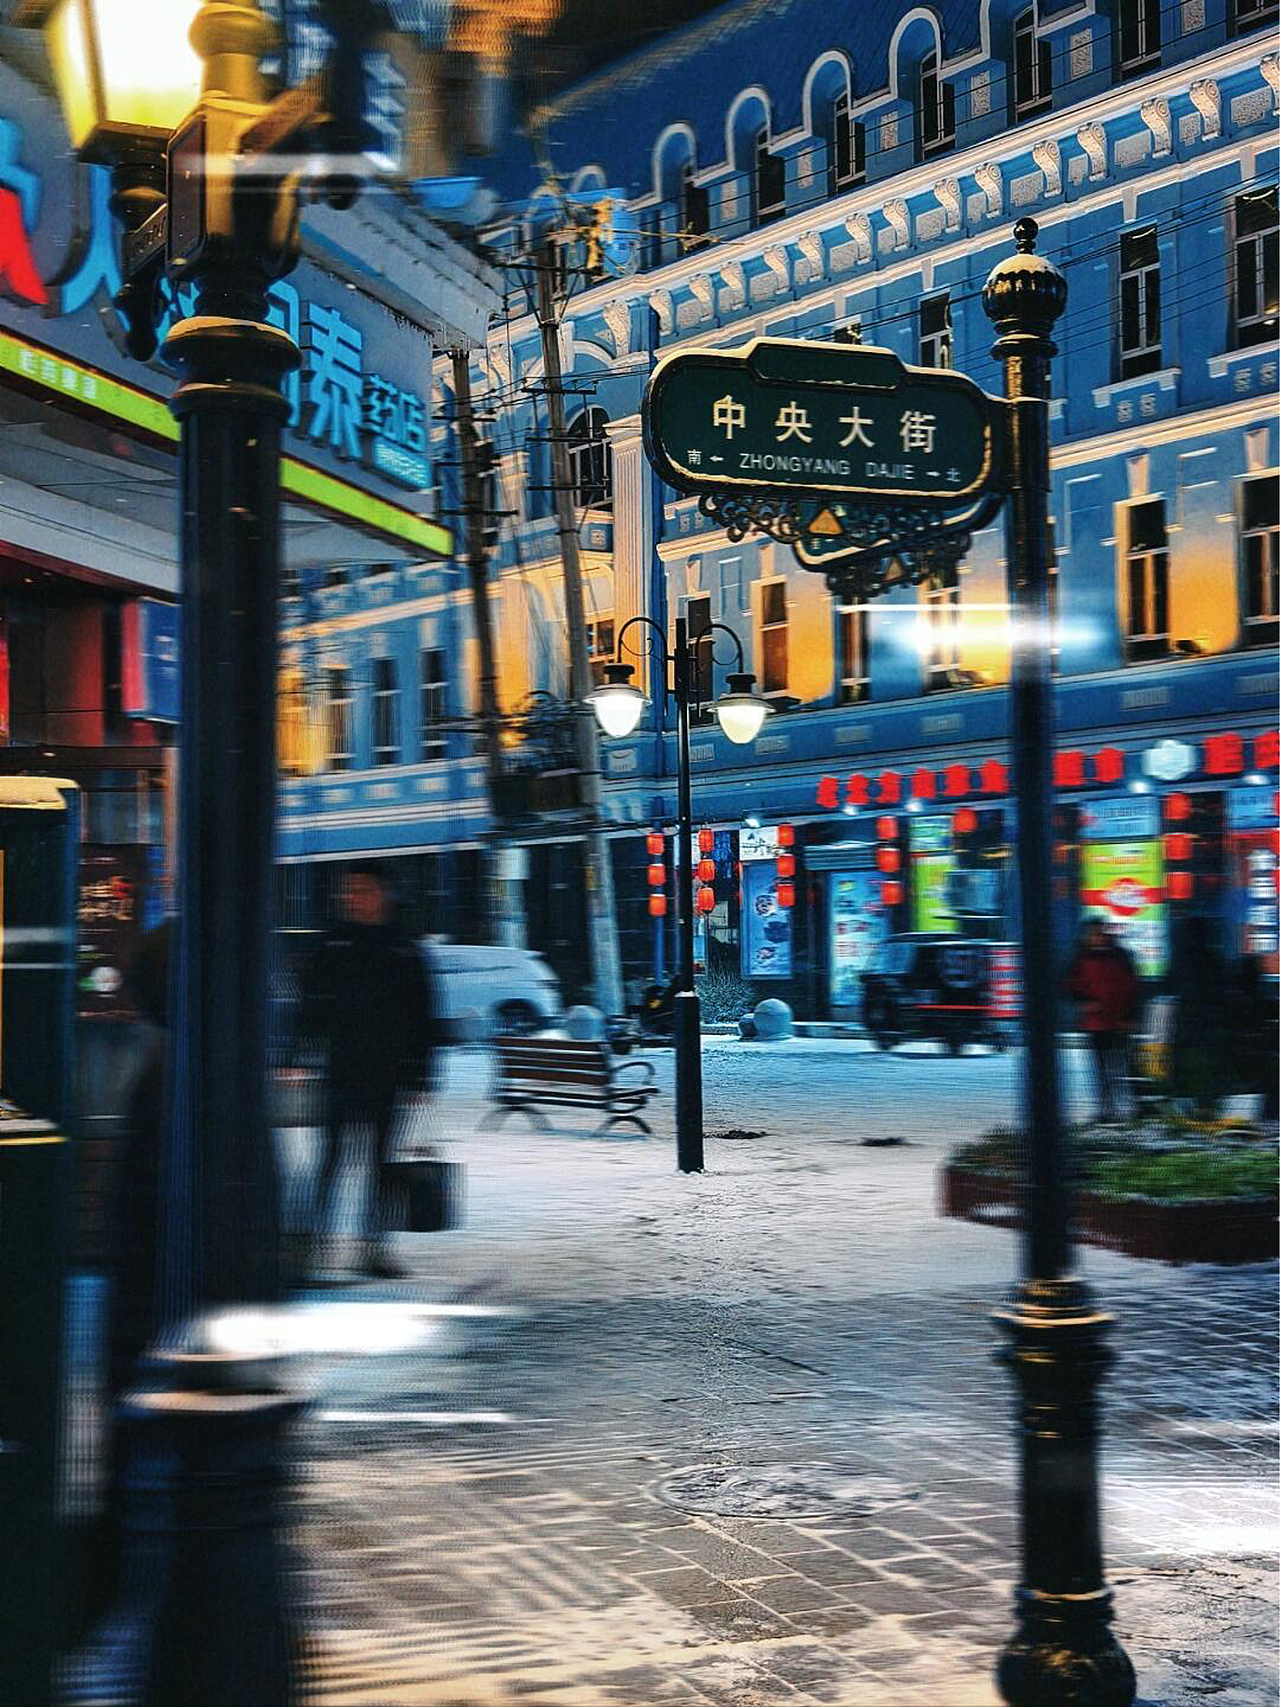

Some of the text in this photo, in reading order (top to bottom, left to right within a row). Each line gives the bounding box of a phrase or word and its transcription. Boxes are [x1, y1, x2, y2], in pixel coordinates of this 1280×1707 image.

[369, 374, 426, 452] 药店
[713, 394, 937, 453] 中央大街
[687, 448, 702, 465] 南
[738, 452, 915, 480] ZHONGYANG DAJIE
